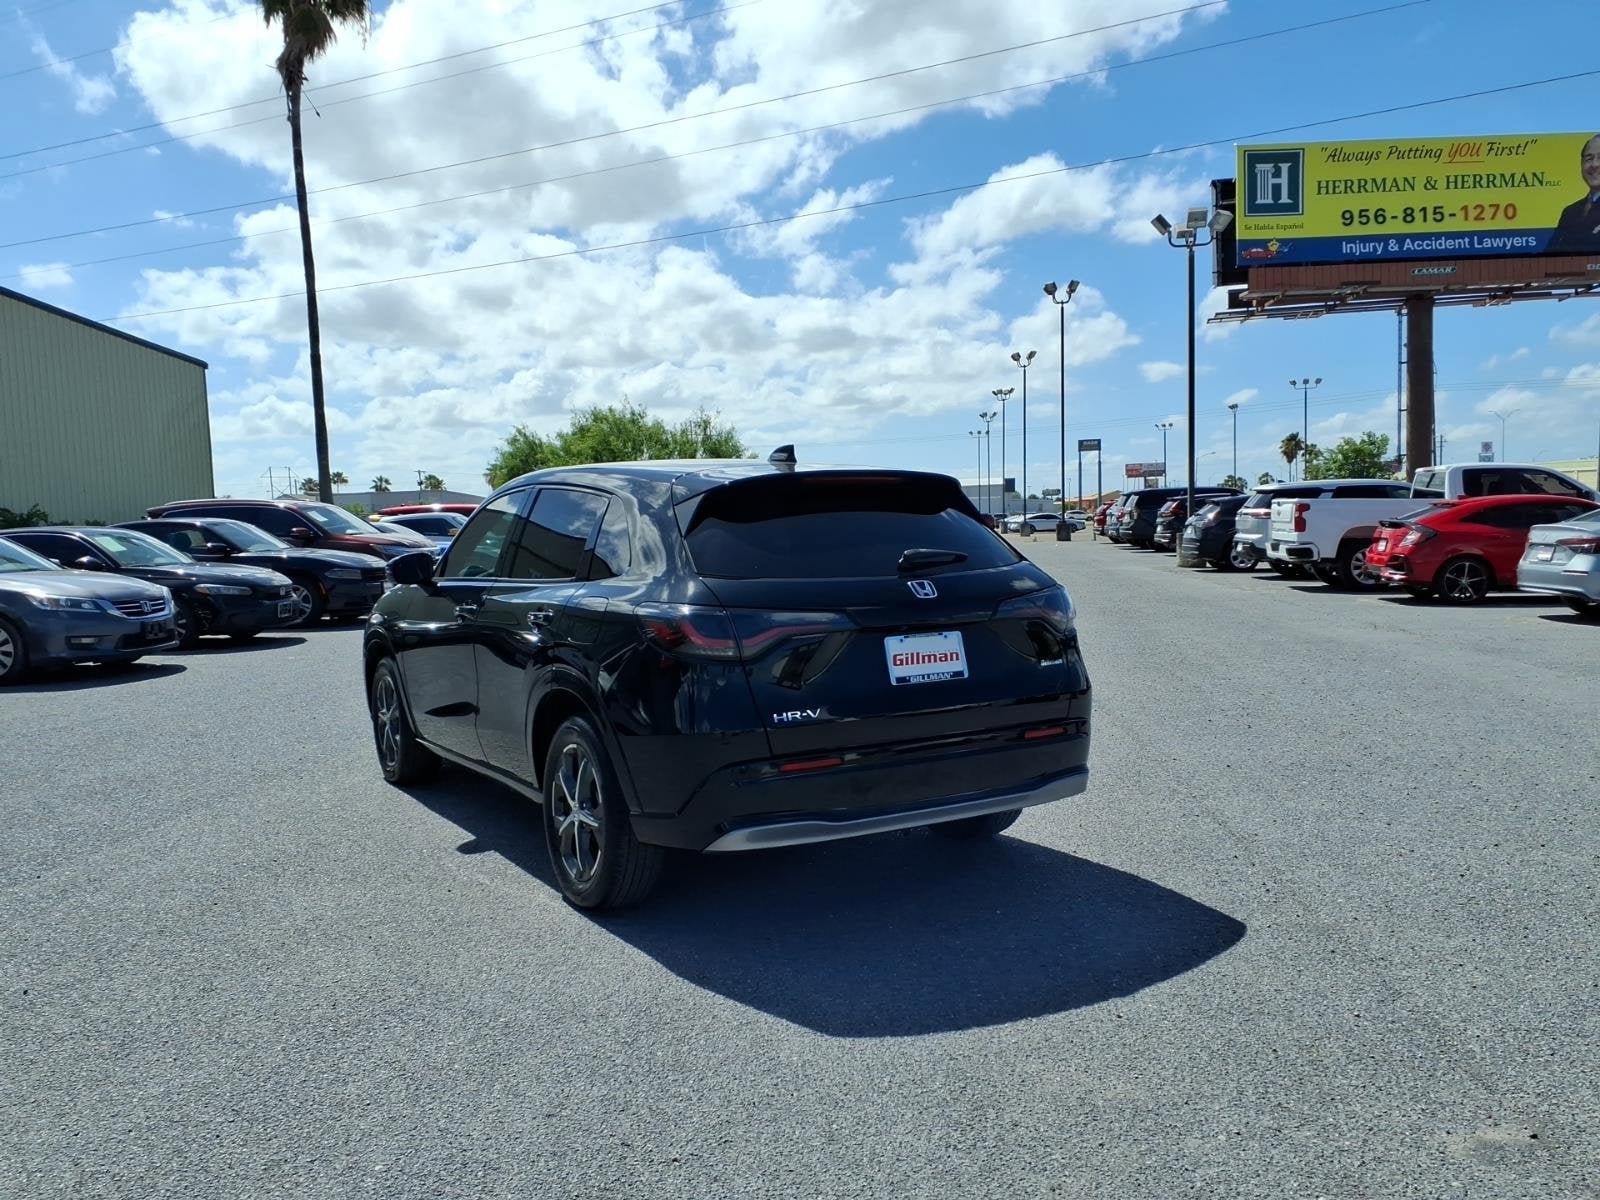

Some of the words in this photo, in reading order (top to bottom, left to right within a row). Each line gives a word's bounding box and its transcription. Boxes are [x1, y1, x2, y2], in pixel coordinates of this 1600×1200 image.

[1321, 146, 1382, 166] "Always
[1386, 145, 1443, 164] Putting
[1448, 142, 1482, 161] YOU
[1316, 176, 1416, 196] HERRMAN
[1423, 176, 1438, 191] &
[1445, 171, 1544, 190] HERRMAN
[1341, 203, 1517, 227] 956-815-1270
[1342, 241, 1383, 256] Injury
[1388, 240, 1399, 251] &
[1403, 237, 1470, 251] Accident
[1474, 235, 1536, 250] Lawyers
[892, 651, 960, 667] Gillman
[773, 707, 820, 723] HR-V
